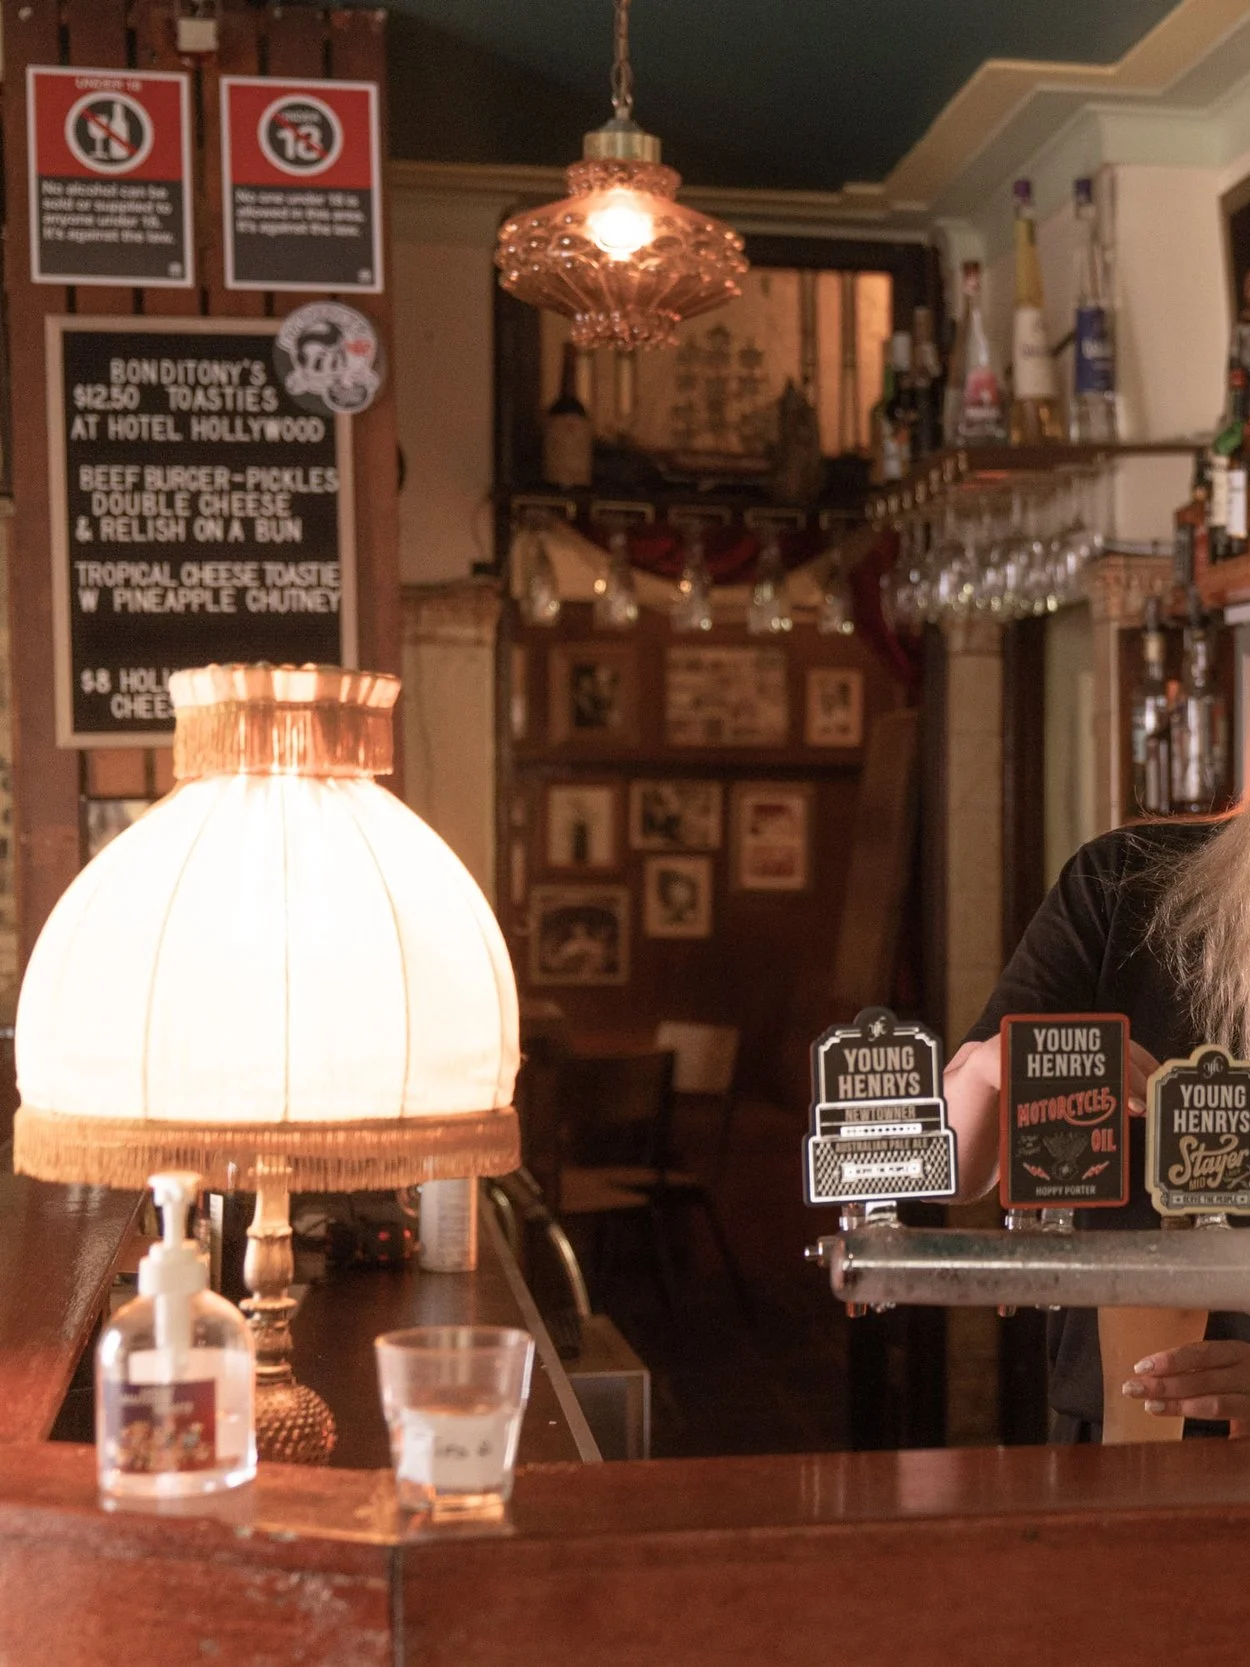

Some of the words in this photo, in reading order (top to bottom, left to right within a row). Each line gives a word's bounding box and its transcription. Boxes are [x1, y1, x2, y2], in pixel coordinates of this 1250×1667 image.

[277, 124, 323, 161] 18
[165, 385, 279, 413] TOASTIES
[70, 414, 100, 441] AT
[107, 414, 183, 442] HOTEL
[190, 415, 326, 443] HOLLYWOOD
[78, 463, 141, 491] BEEF
[91, 490, 191, 518] DOUBLE
[198, 490, 292, 518] CHEESE
[75, 515, 94, 543] &
[101, 516, 187, 543] RELISH
[193, 516, 225, 542] ON
[229, 517, 246, 543] A
[254, 516, 303, 543] BUN
[75, 561, 179, 588] TROPICAL
[180, 561, 261, 588] CHEESE
[77, 588, 100, 614] W
[112, 587, 237, 614] PINEAPPLE
[245, 588, 342, 613] CHUTNEY
[110, 693, 175, 719] CHEE
[1033, 1028, 1101, 1051] YOUNG
[843, 1046, 915, 1074] YOUNG
[1027, 1054, 1106, 1078] HENRYS
[838, 1073, 921, 1100] HENRYS
[1179, 1084, 1247, 1108] YOUNG
[844, 1105, 916, 1121] NEWTOWNER
[1017, 1086, 1116, 1128] MOTORCYCLE
[1173, 1109, 1250, 1133] HENRYS
[835, 1139, 888, 1153] AUSTRALIAN
[1090, 1128, 1117, 1153] OIL
[1168, 1134, 1250, 1188] Stayer
[1036, 1185, 1063, 1196] HOPPY
[1064, 1184, 1096, 1195] PORTER
